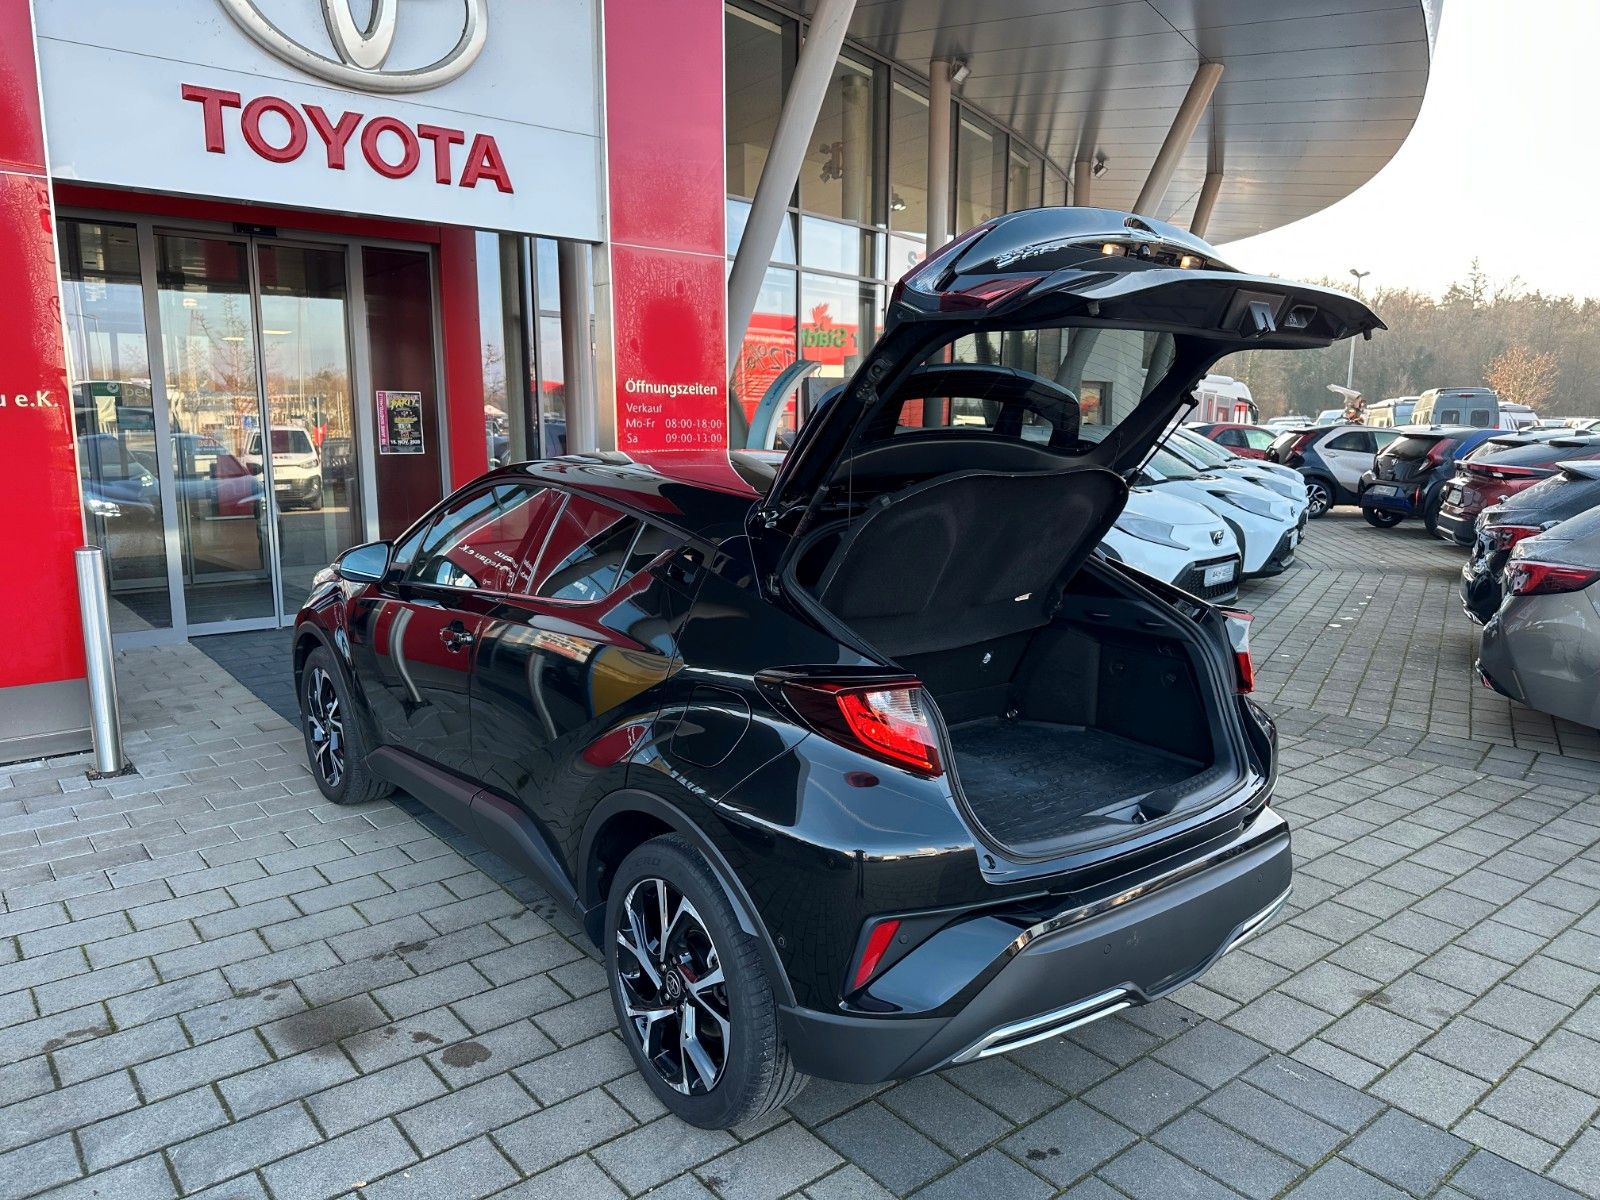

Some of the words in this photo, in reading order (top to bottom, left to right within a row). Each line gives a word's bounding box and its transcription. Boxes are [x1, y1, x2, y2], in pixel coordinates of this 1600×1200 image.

[181, 83, 514, 194] TOYOTA
[625, 378, 717, 397] Öffnungszeiten
[14, 391, 59, 407] e.K.
[626, 403, 662, 413] Verkauf
[626, 418, 655, 428] Mo-Fr
[665, 419, 722, 429] 08:00-18:00
[627, 433, 638, 443] Sa
[665, 433, 722, 443] 09:00-13:00
